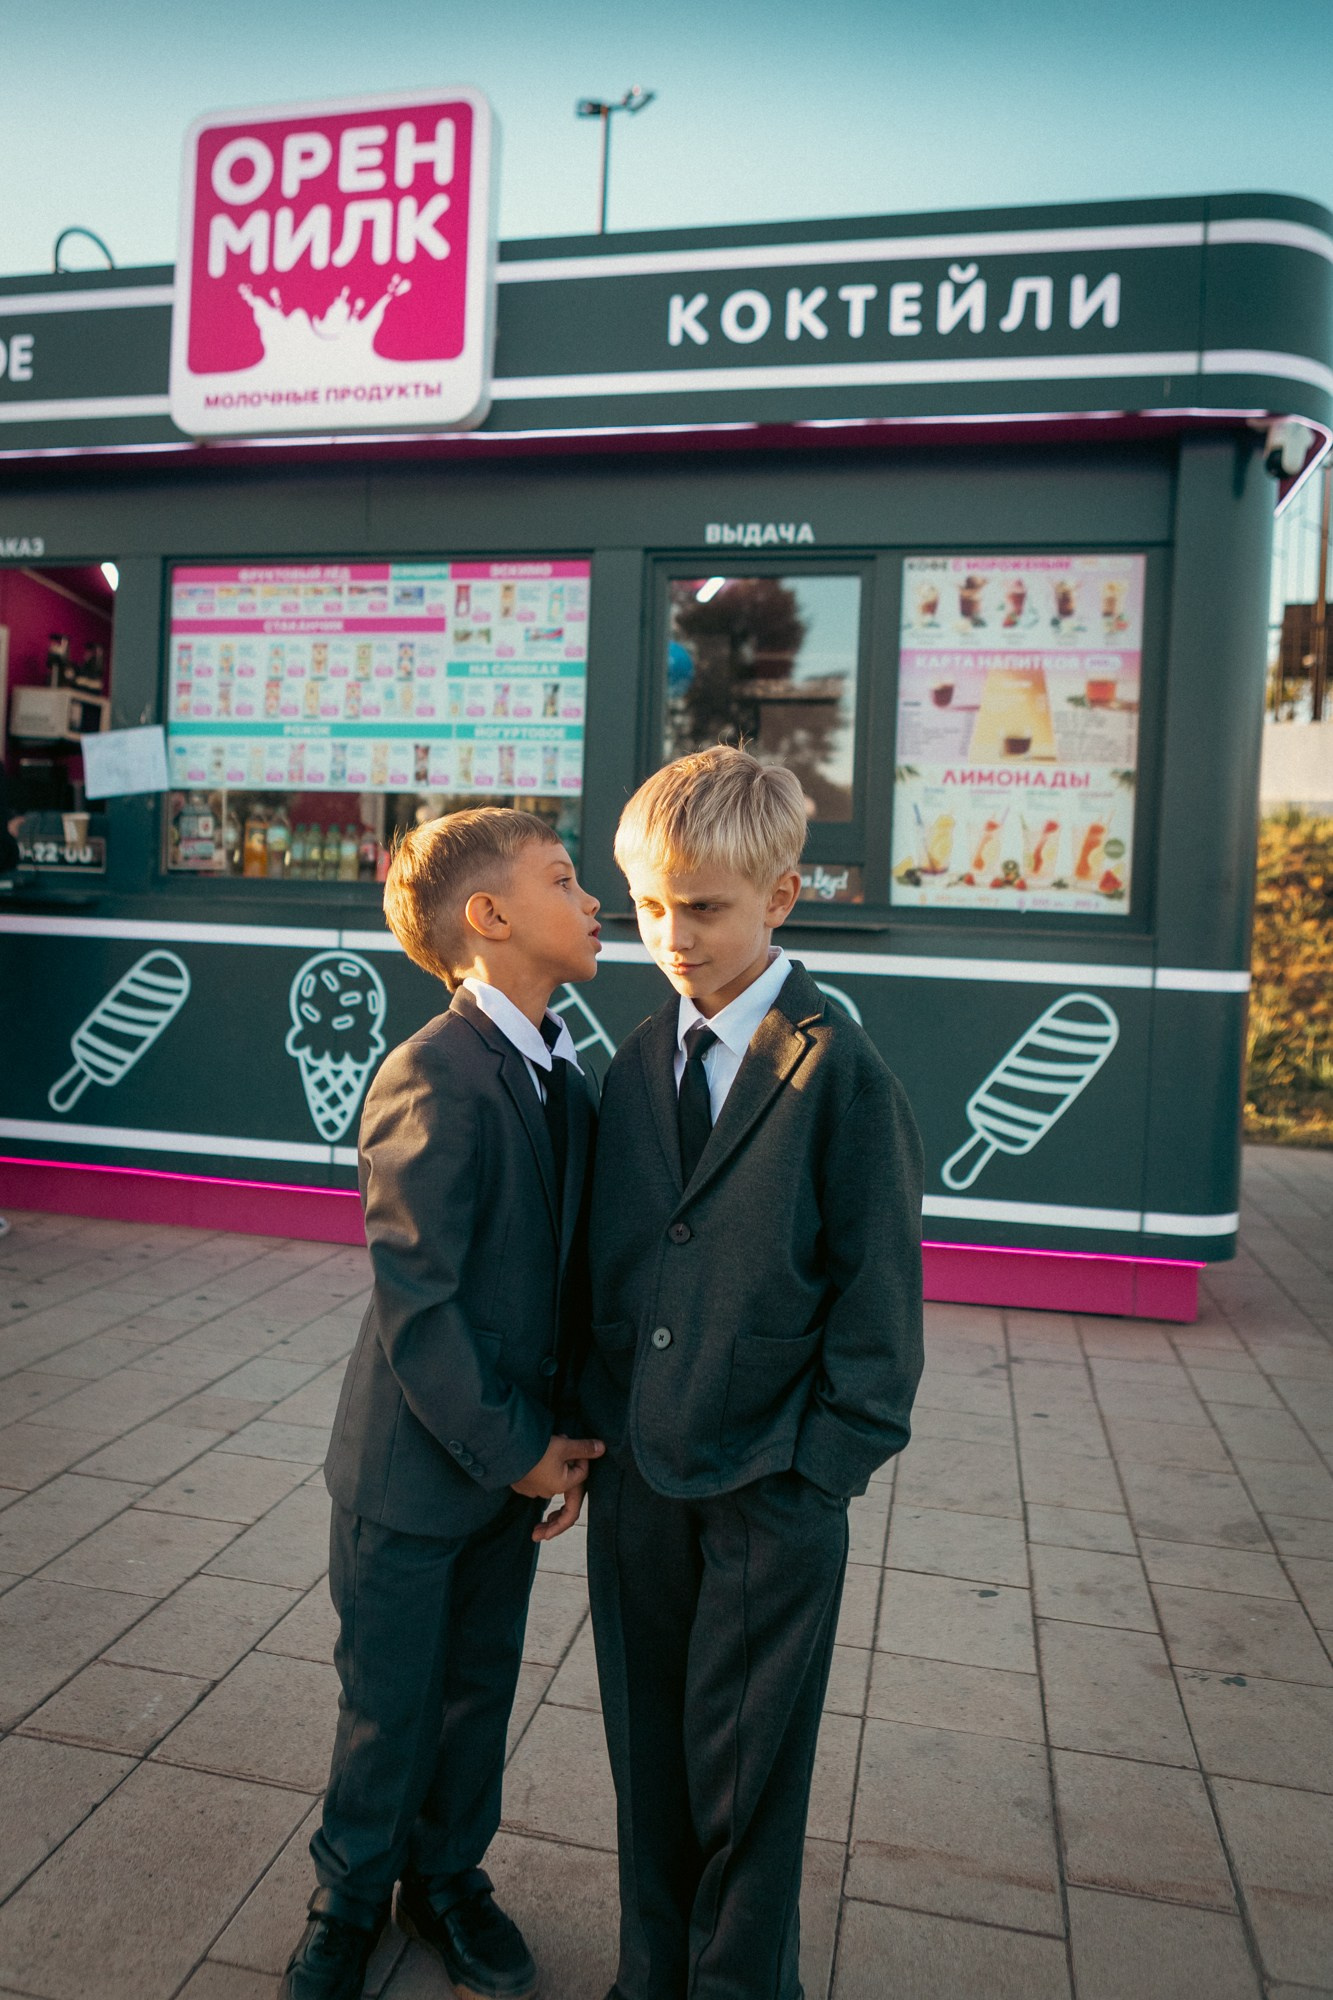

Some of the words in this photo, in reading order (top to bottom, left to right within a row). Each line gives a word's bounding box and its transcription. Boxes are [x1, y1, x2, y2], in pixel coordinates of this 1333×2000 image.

[210, 116, 455, 206] ОРЕН
[207, 192, 451, 279] МИЛК
[667, 262, 1122, 347] КОКТЕЙЛИ
[204, 388, 320, 410] МОЛОЧНЫЕ
[325, 382, 442, 403] ПРОДУКТЫ
[704, 522, 815, 547] ВЫДАЧА
[916, 655, 974, 669] КАРТА
[942, 769, 1092, 789] ЛИМОНАДЫ
